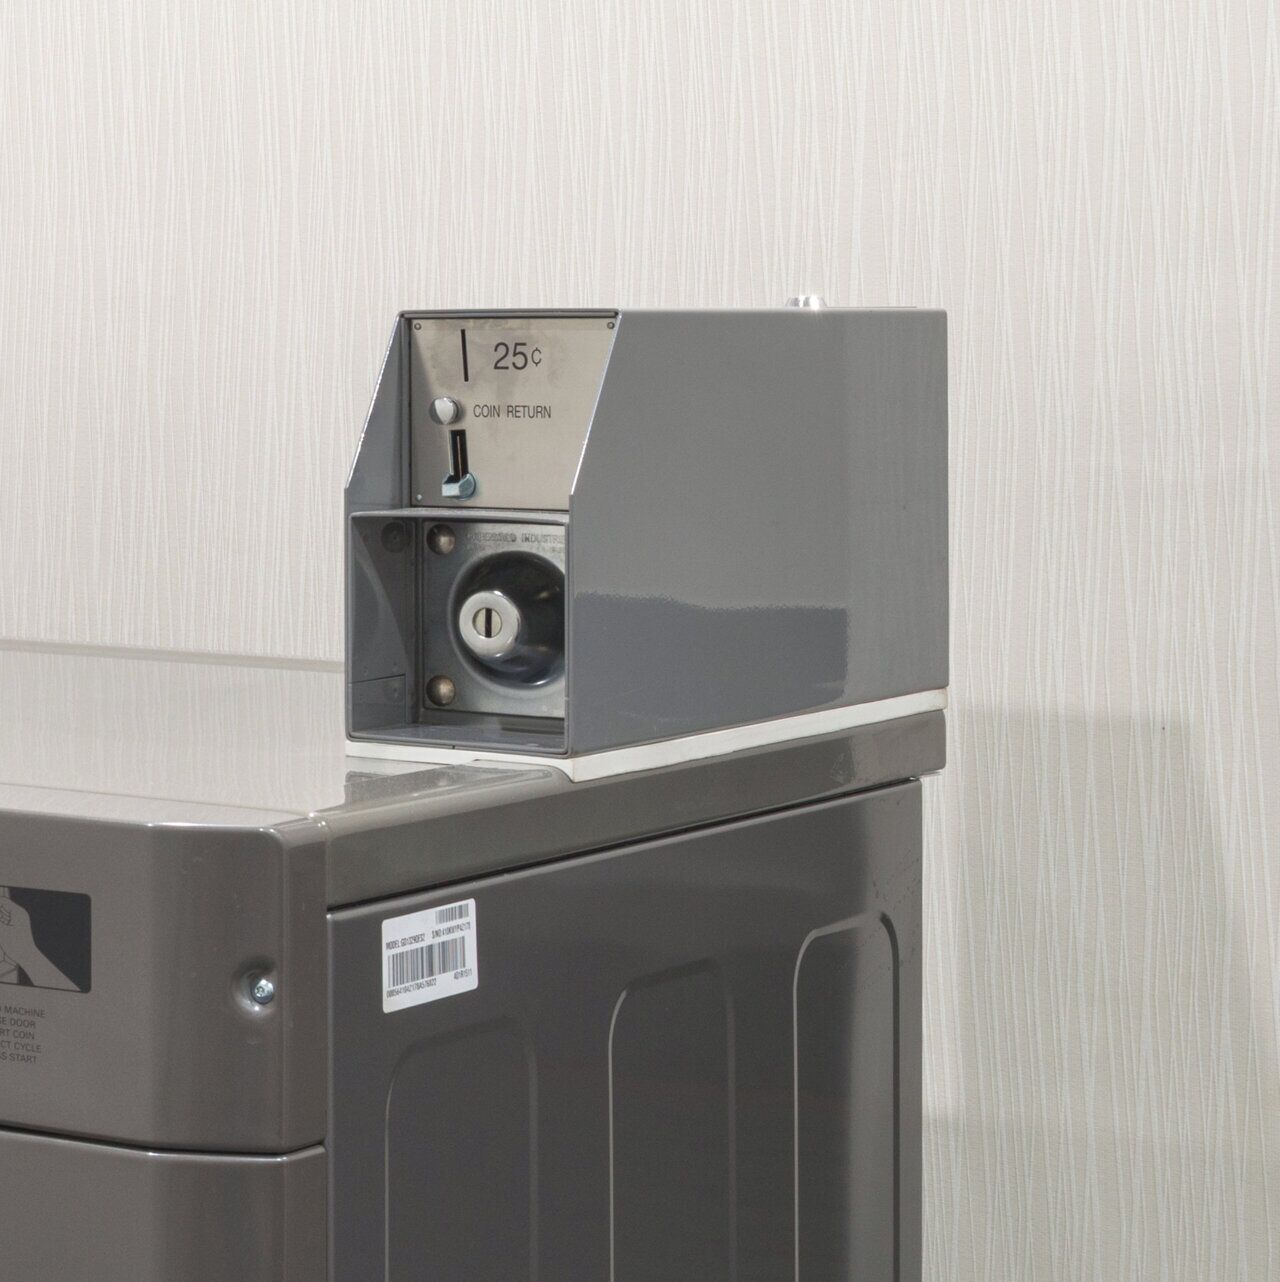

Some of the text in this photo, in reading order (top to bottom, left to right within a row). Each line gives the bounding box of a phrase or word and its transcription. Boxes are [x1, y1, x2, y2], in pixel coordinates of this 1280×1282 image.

[494, 342, 542, 370] 25¢
[473, 405, 551, 419] COIN RETURN
[4, 1006, 46, 1018] MACHINE
[10, 1018, 36, 1029] DOOR
[13, 1029, 35, 1040] COIN
[14, 1041, 42, 1053] CYCLE
[9, 1053, 37, 1064] START
